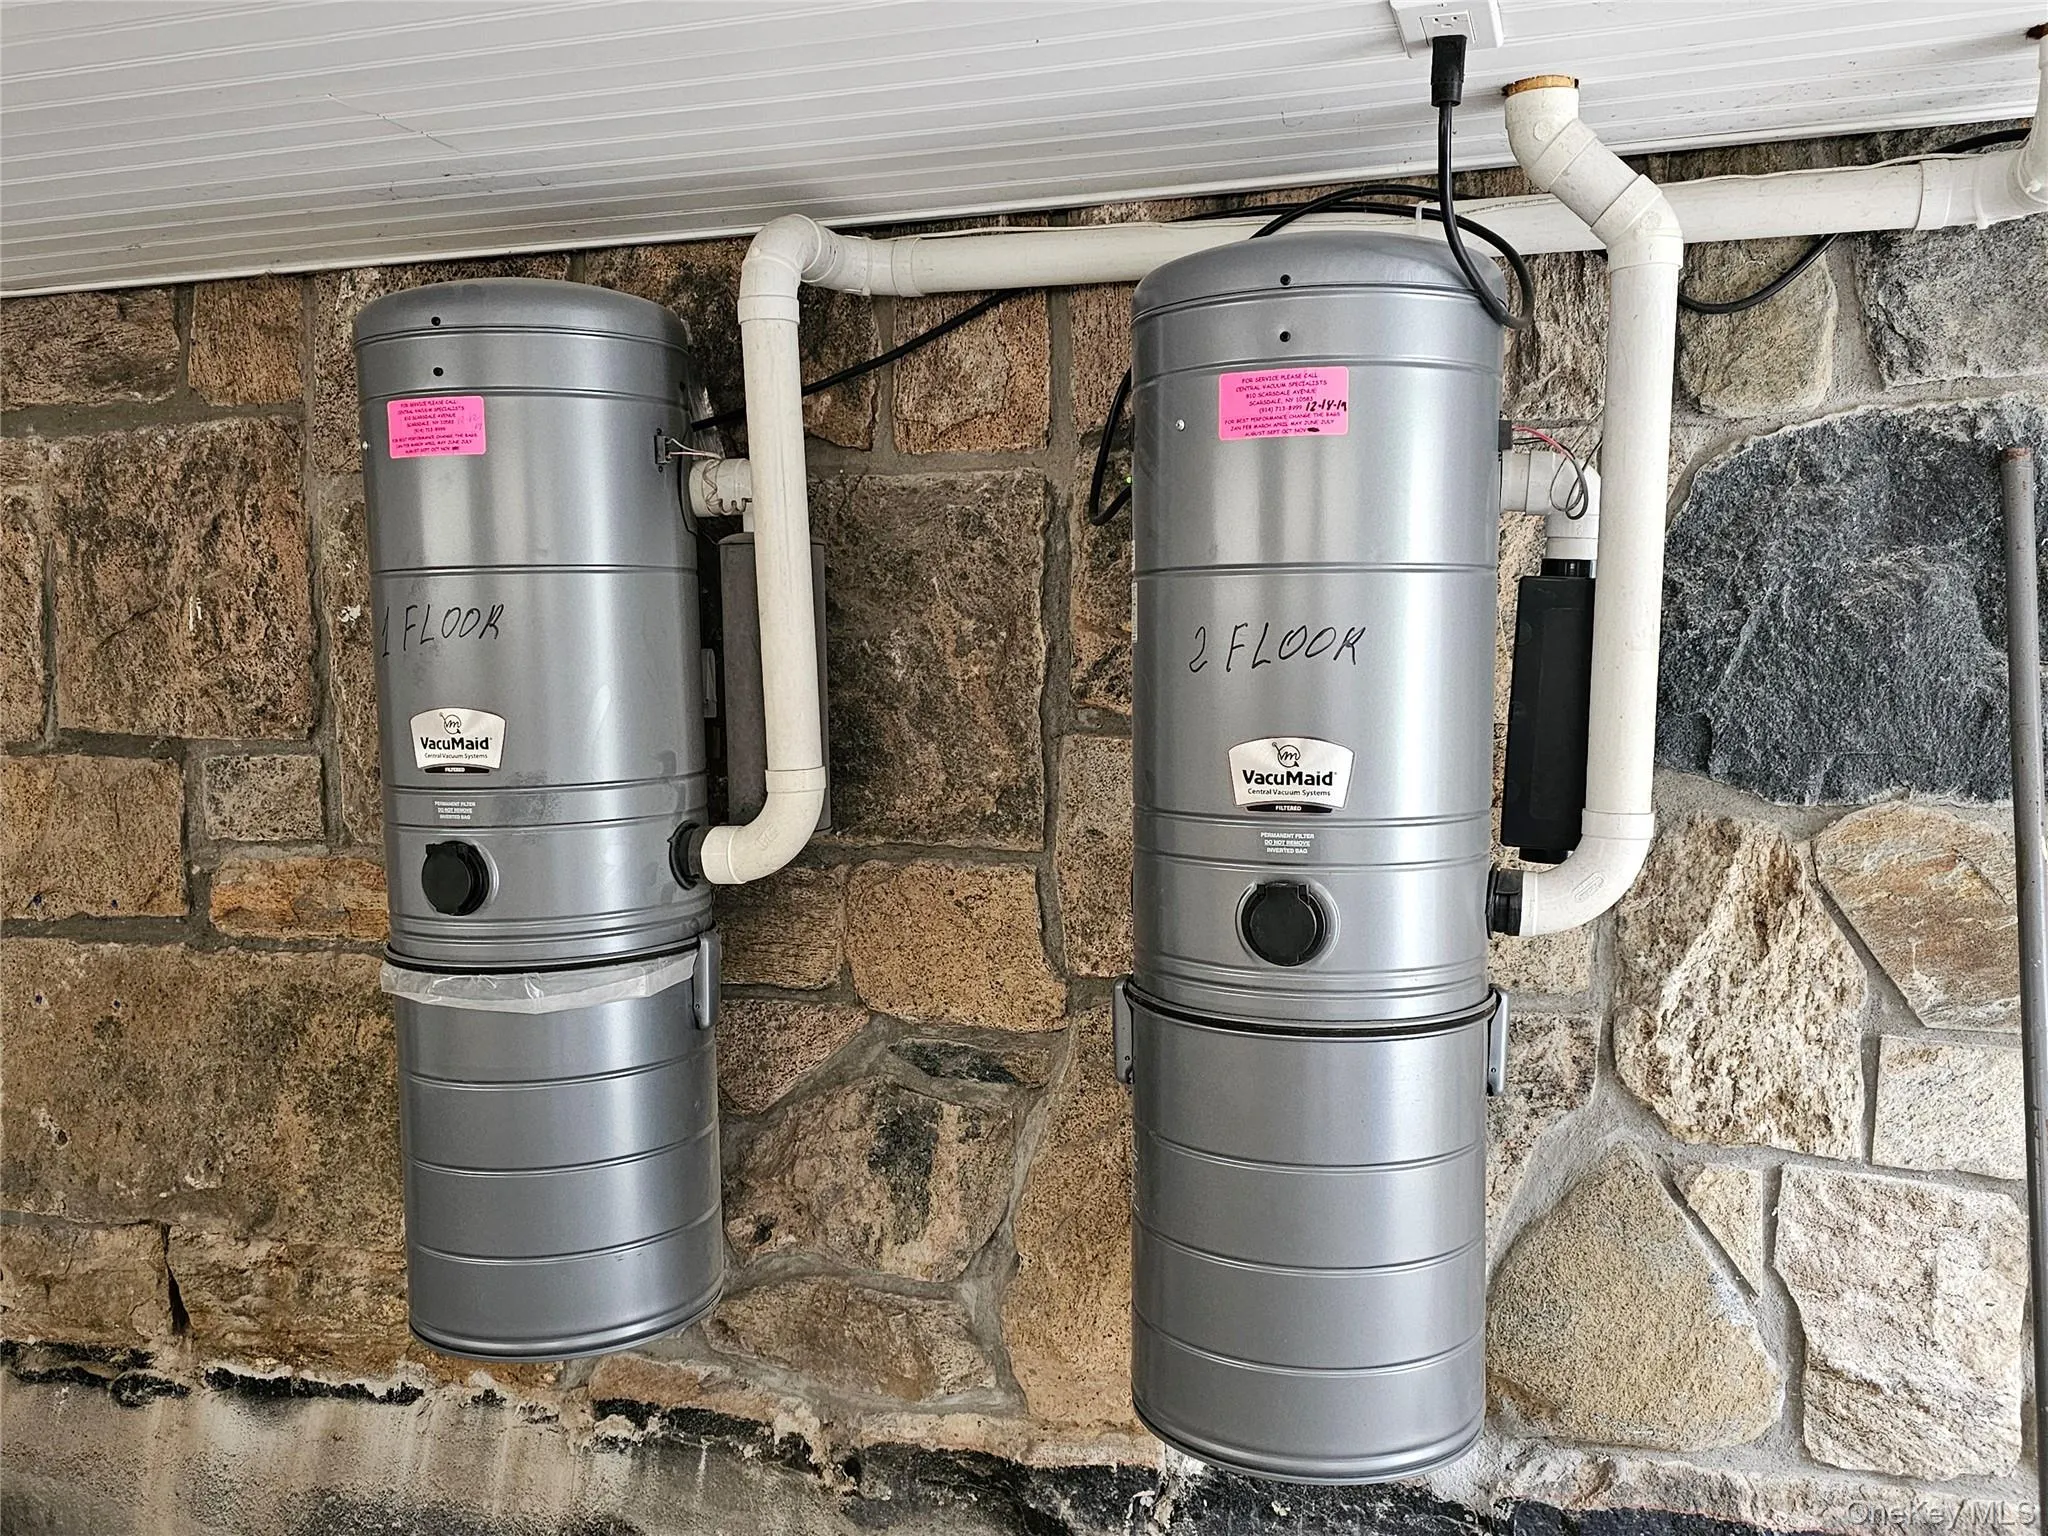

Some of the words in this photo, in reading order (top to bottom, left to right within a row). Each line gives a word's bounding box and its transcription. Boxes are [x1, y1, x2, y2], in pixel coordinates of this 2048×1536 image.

[1251, 414, 1287, 422] PERFORMANCE
[382, 606, 389, 658] 1
[404, 603, 504, 651] FLOOR
[1189, 626, 1208, 672] 2
[1226, 622, 1366, 672] FLOOR
[420, 737, 489, 750] VacuMaid
[1243, 770, 1333, 786] VacuMaid
